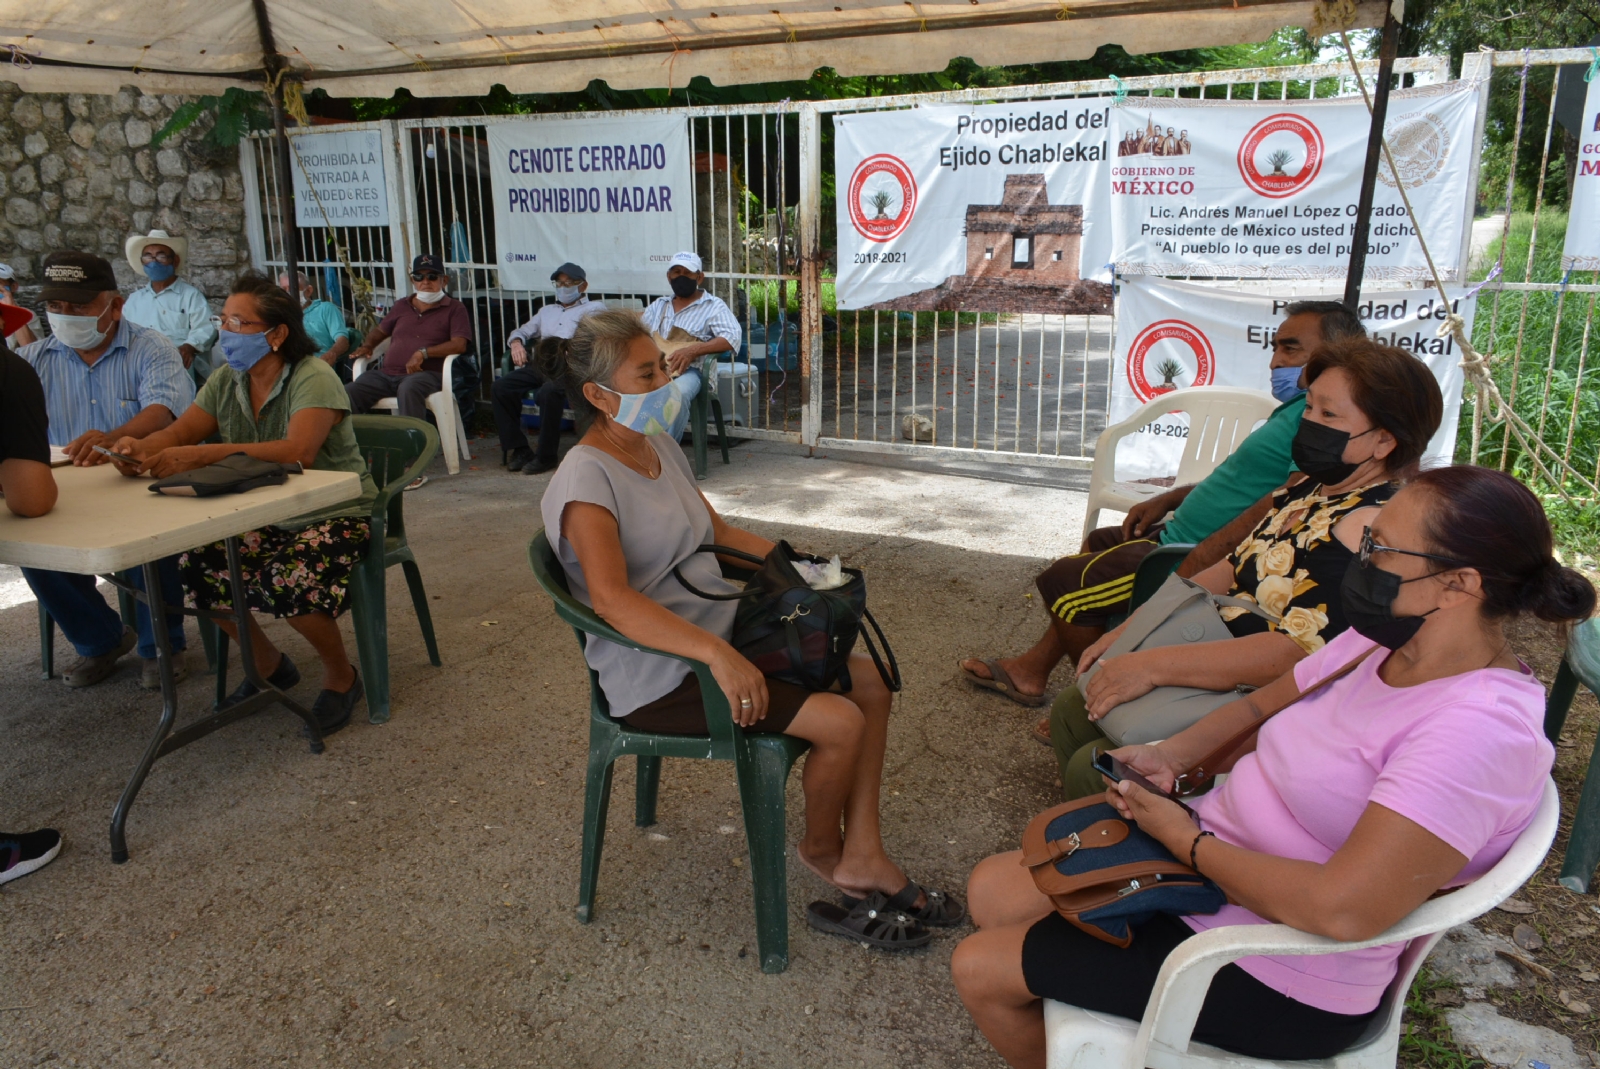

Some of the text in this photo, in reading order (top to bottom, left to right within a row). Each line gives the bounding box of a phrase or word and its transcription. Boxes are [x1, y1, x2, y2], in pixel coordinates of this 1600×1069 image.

[957, 107, 1110, 138] Propiedad del
[297, 152, 376, 168] PROHIBIDA LA
[508, 143, 666, 174] CENOTE CERRADO
[940, 141, 1107, 171] Ejido Chablekal
[305, 170, 370, 184] ENTRADA A
[1112, 166, 1195, 176] GOBIERNO DE
[1112, 176, 1195, 195] MÉXICO
[508, 186, 673, 213] PROHIBIDO NADAR
[1150, 206, 1174, 218] Lic.
[1178, 206, 1230, 218] Andrés
[1234, 206, 1289, 218] Manuel
[1293, 205, 1341, 220] López
[1141, 223, 1216, 236] Presidente
[1221, 224, 1239, 236] de
[1243, 223, 1296, 236] México
[1301, 223, 1344, 236] usted
[1181, 242, 1230, 256] pueblo
[1235, 242, 1248, 254] lo
[1253, 244, 1280, 257] que
[1285, 244, 1302, 255] es
[1308, 242, 1331, 254] del
[515, 254, 536, 262] INAH
[854, 252, 907, 264] 2018-2021
[1417, 299, 1459, 320] del
[1197, 354, 1208, 384] LEALTAD
